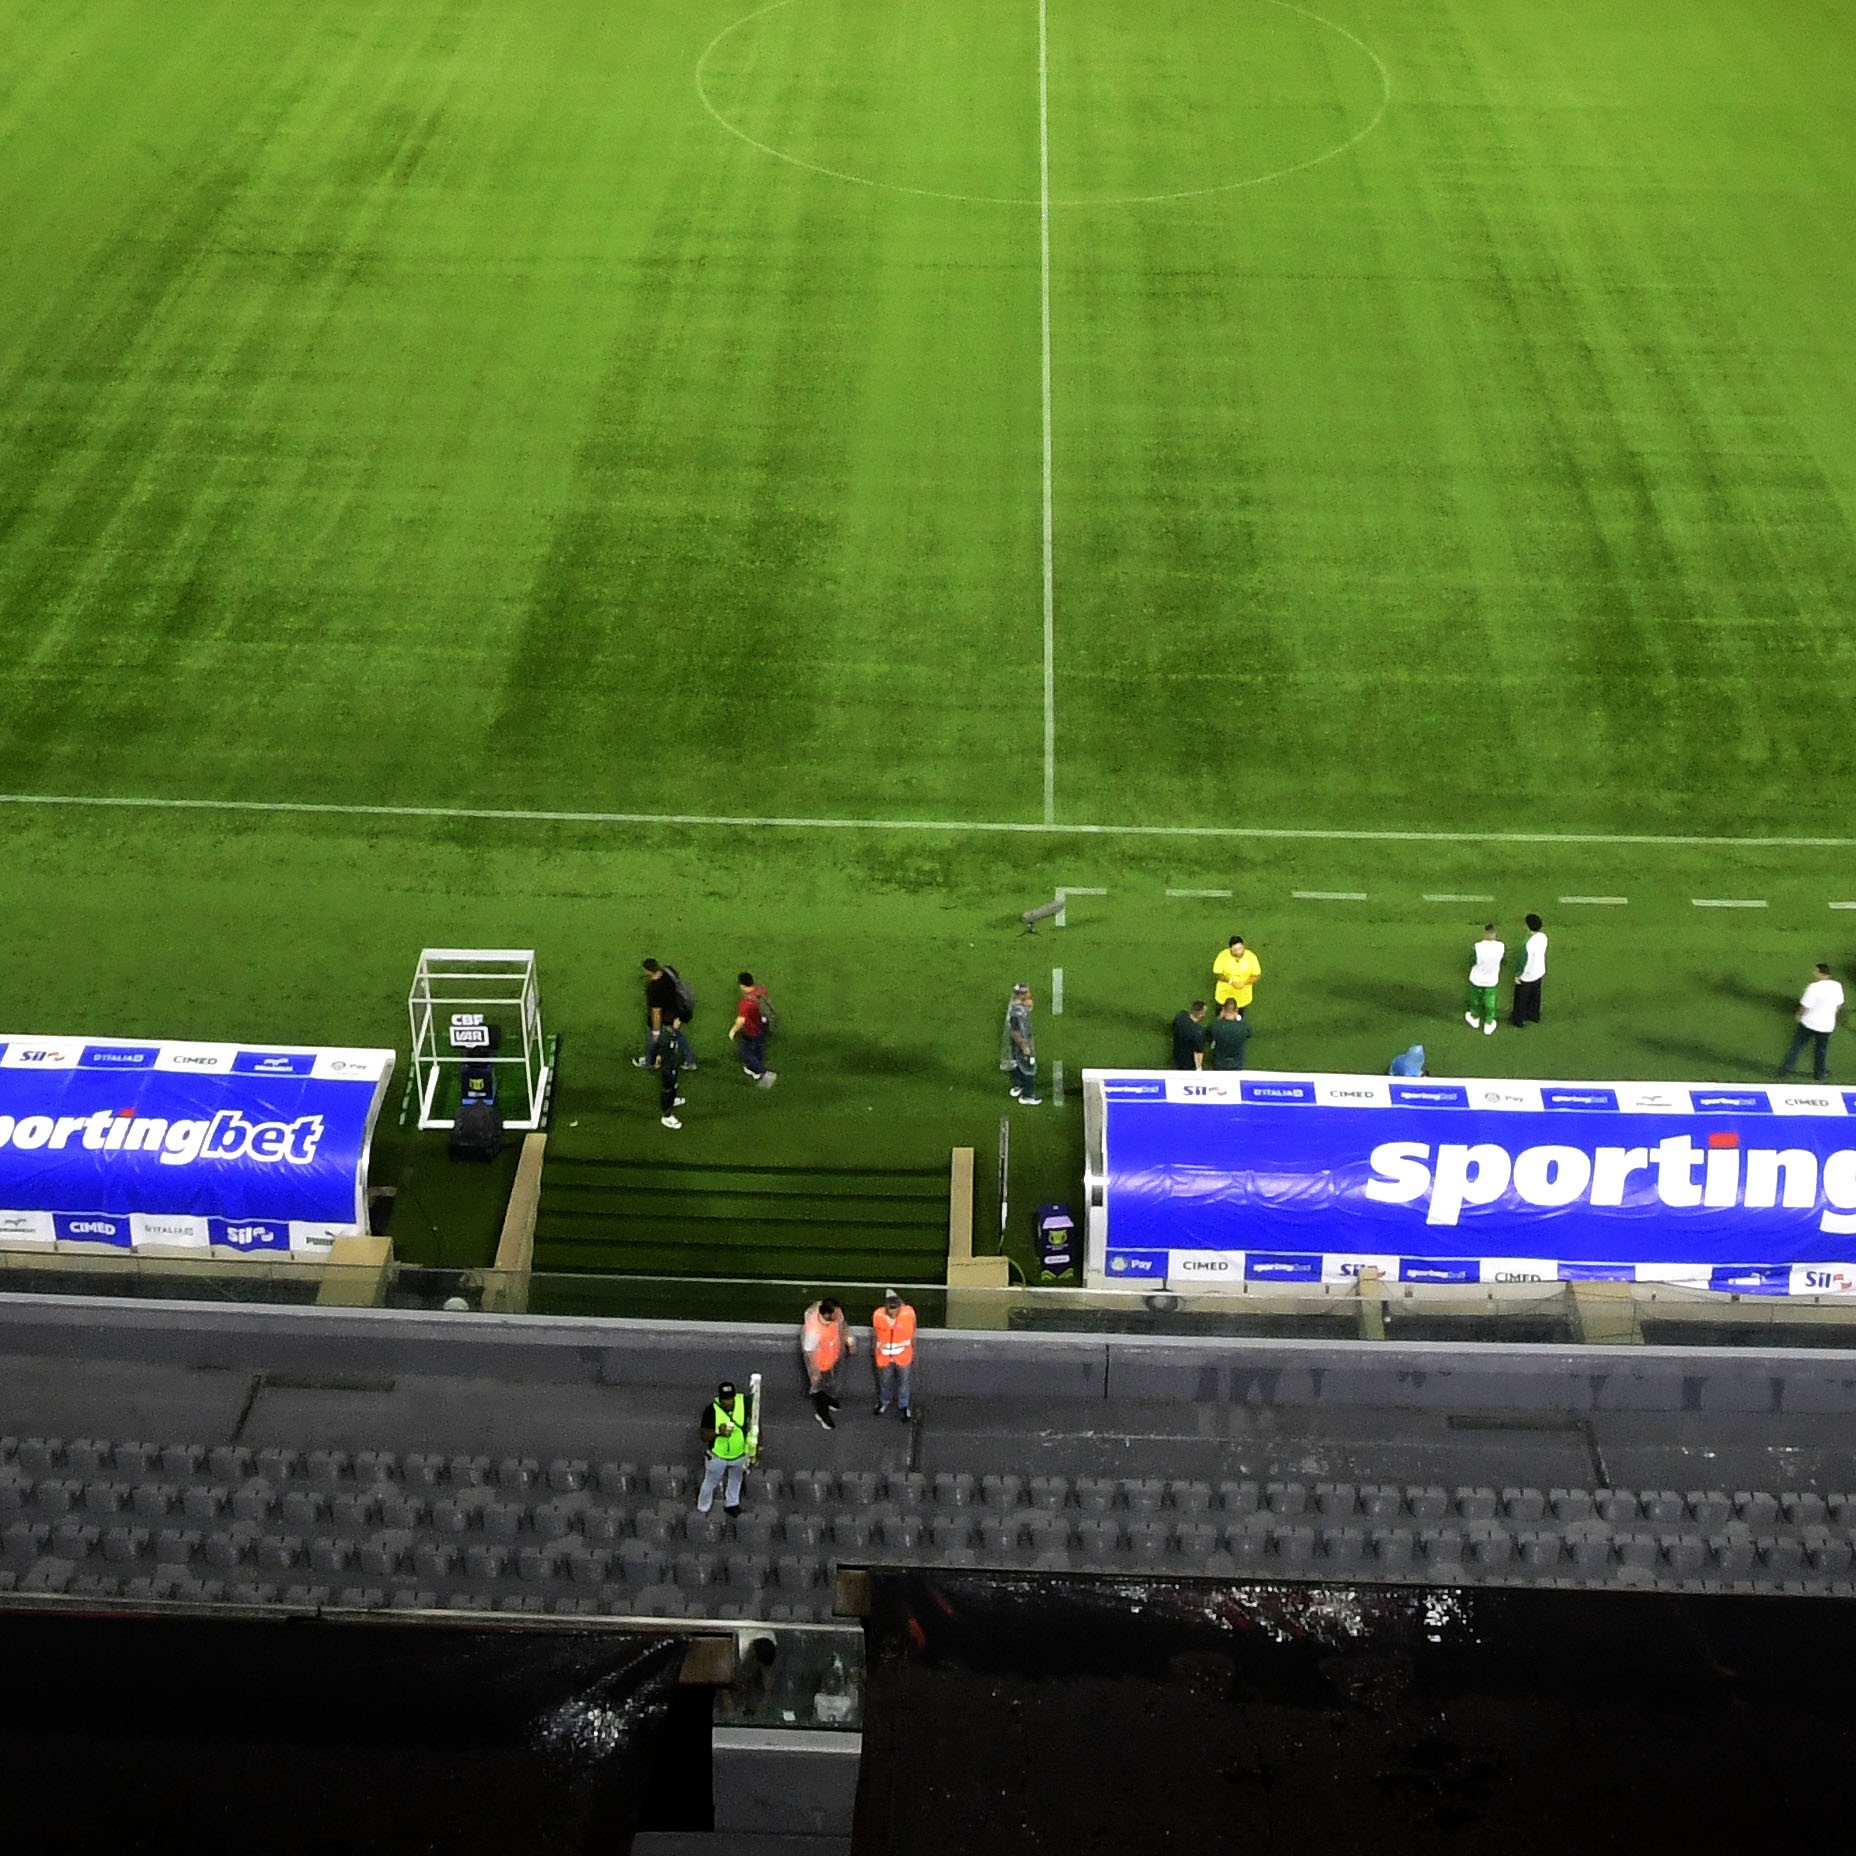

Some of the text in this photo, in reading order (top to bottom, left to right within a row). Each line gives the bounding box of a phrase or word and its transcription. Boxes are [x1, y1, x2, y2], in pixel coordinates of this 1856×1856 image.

[455, 1030, 483, 1042] VAR
[173, 1055, 218, 1065] CIMED
[1329, 1090, 1375, 1099] CIMED
[1784, 1097, 1830, 1107] CIMED
[68, 1221, 117, 1236] CIMED
[1130, 1258, 1153, 1271] Pay
[1182, 1260, 1229, 1272] CIMED
[1805, 1270, 1832, 1288] Sil
